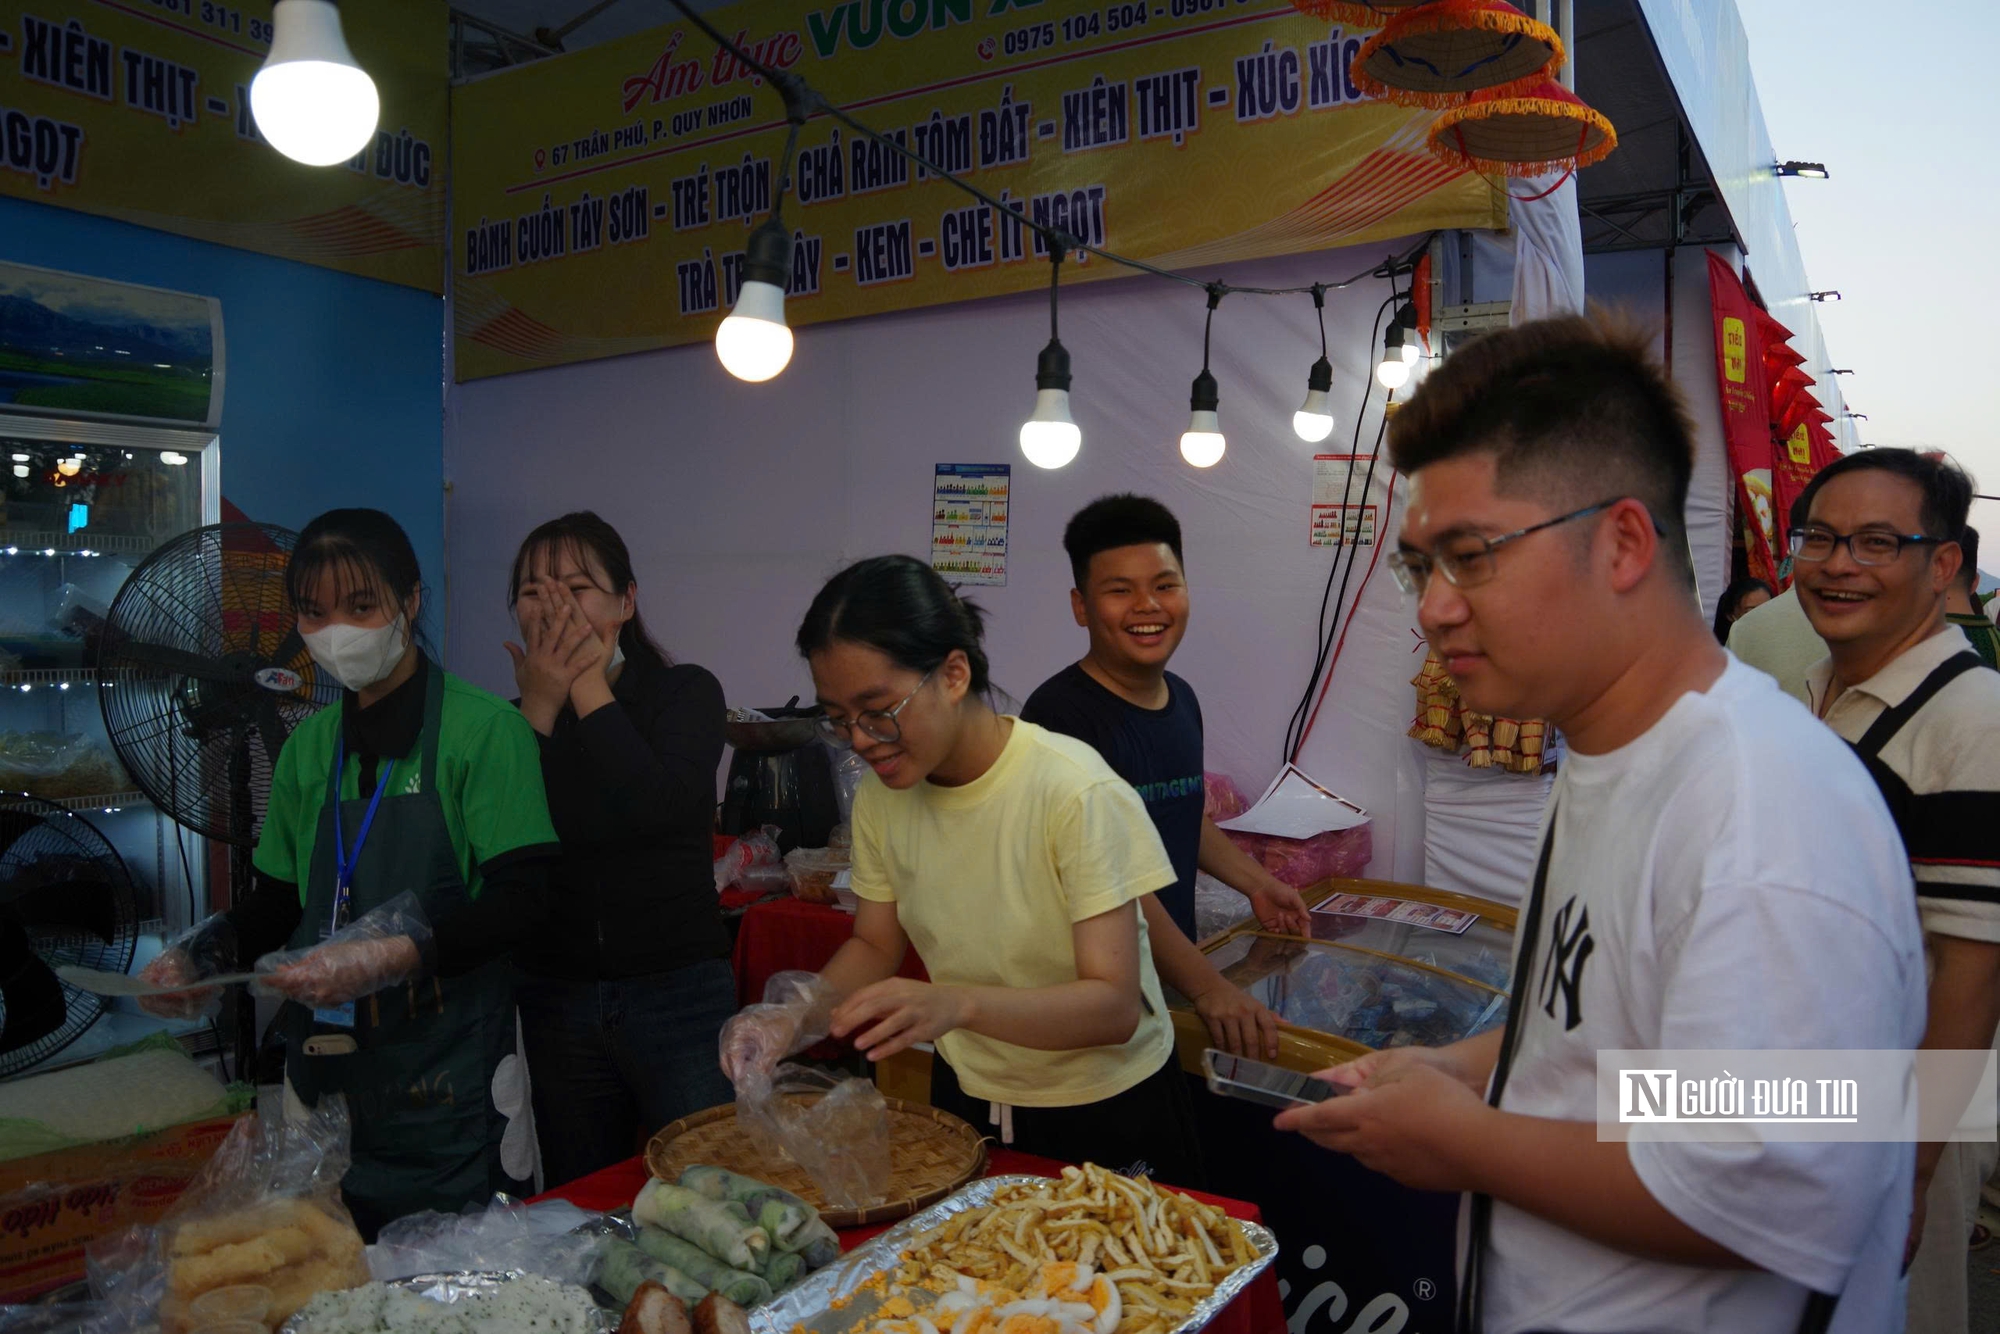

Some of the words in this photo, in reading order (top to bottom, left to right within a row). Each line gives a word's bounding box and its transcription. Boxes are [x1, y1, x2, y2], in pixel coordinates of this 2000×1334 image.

[249, 19, 273, 44] 39
[1005, 24, 1054, 54] 0975
[1062, 14, 1100, 42] 104
[1107, 2, 1146, 32] 504
[23, 16, 110, 97] XIÊN
[123, 49, 197, 128] THỊT
[374, 126, 430, 187] ĐỨC
[623, 31, 703, 113] Ẩm
[0, 110, 80, 186] GỌT
[466, 218, 512, 274] BÁNH
[517, 195, 565, 263] CUỐN
[570, 194, 603, 250] TÂY
[609, 186, 647, 242] SƠN
[672, 165, 709, 229] TRÉ
[715, 154, 770, 226] TRỘN
[799, 129, 844, 202] CHẢ
[852, 129, 906, 191] RAM
[915, 110, 971, 178] TÔM
[979, 87, 1029, 167] ĐẤT
[1063, 77, 1127, 151] XIÊN
[1135, 69, 1199, 143] THỊT
[1237, 42, 1299, 119] XÚC
[1309, 29, 1371, 106] XÍC
[552, 147, 569, 166] 67
[573, 131, 609, 160] TRẦN
[614, 120, 648, 150] PHÚ,
[653, 120, 667, 140] P.
[672, 110, 702, 137] QUY
[707, 97, 752, 127] NHƠN
[677, 246, 718, 313] TRÀ
[722, 252, 747, 304] TR
[856, 221, 912, 283] KEM
[942, 197, 993, 268] CHÈ
[1000, 192, 1024, 259] ÍT
[1033, 187, 1105, 261] NGỌT
[1539, 894, 1595, 1032] NY
